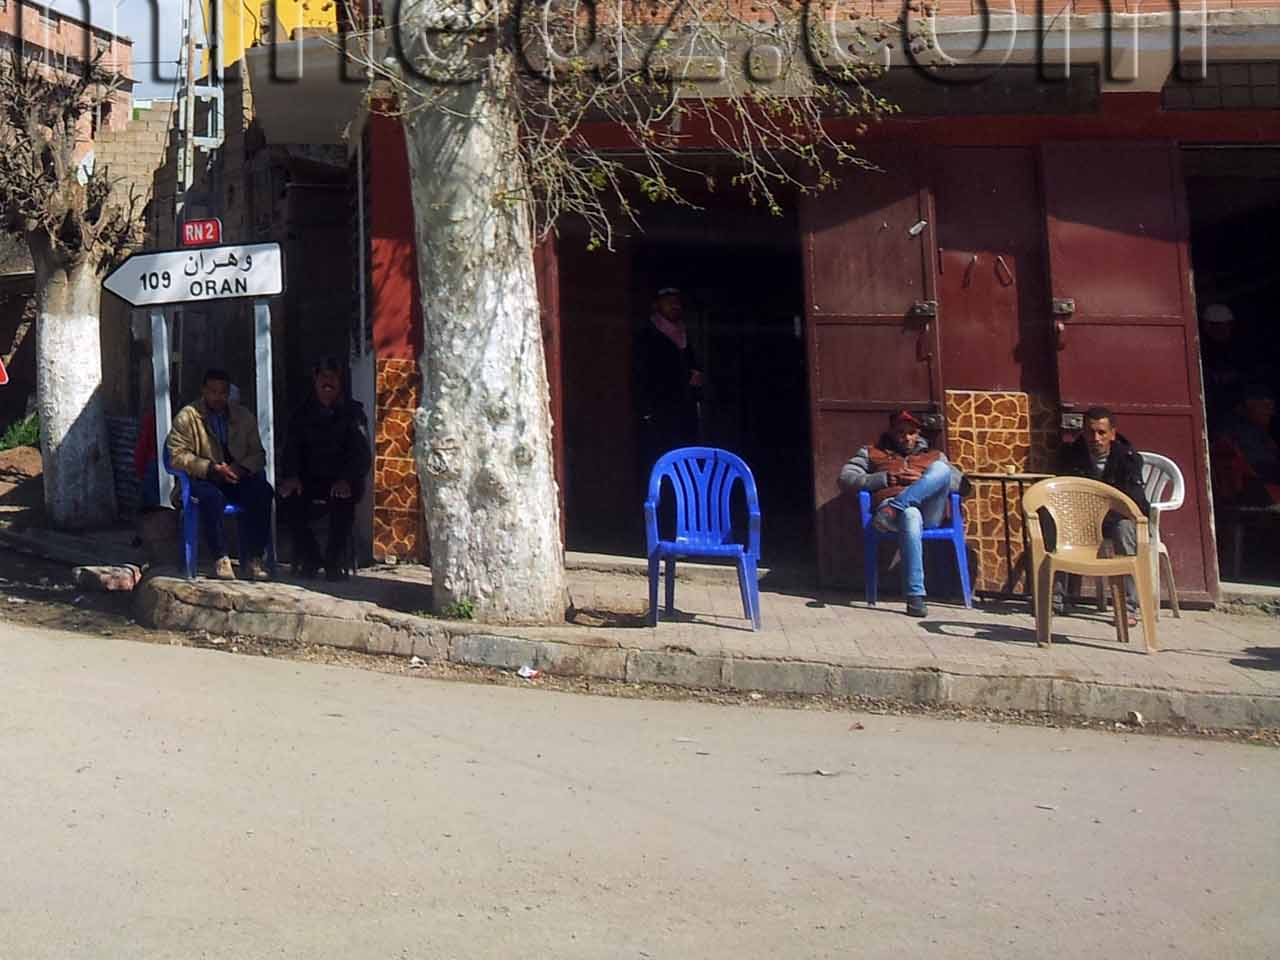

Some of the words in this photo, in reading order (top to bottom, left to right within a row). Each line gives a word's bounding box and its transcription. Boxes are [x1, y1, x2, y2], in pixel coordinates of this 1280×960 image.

[185, 223, 203, 241] RN
[206, 222, 214, 240] 2
[184, 251, 252, 277] وهران
[139, 271, 172, 291] 109
[189, 277, 248, 297] ORAN
